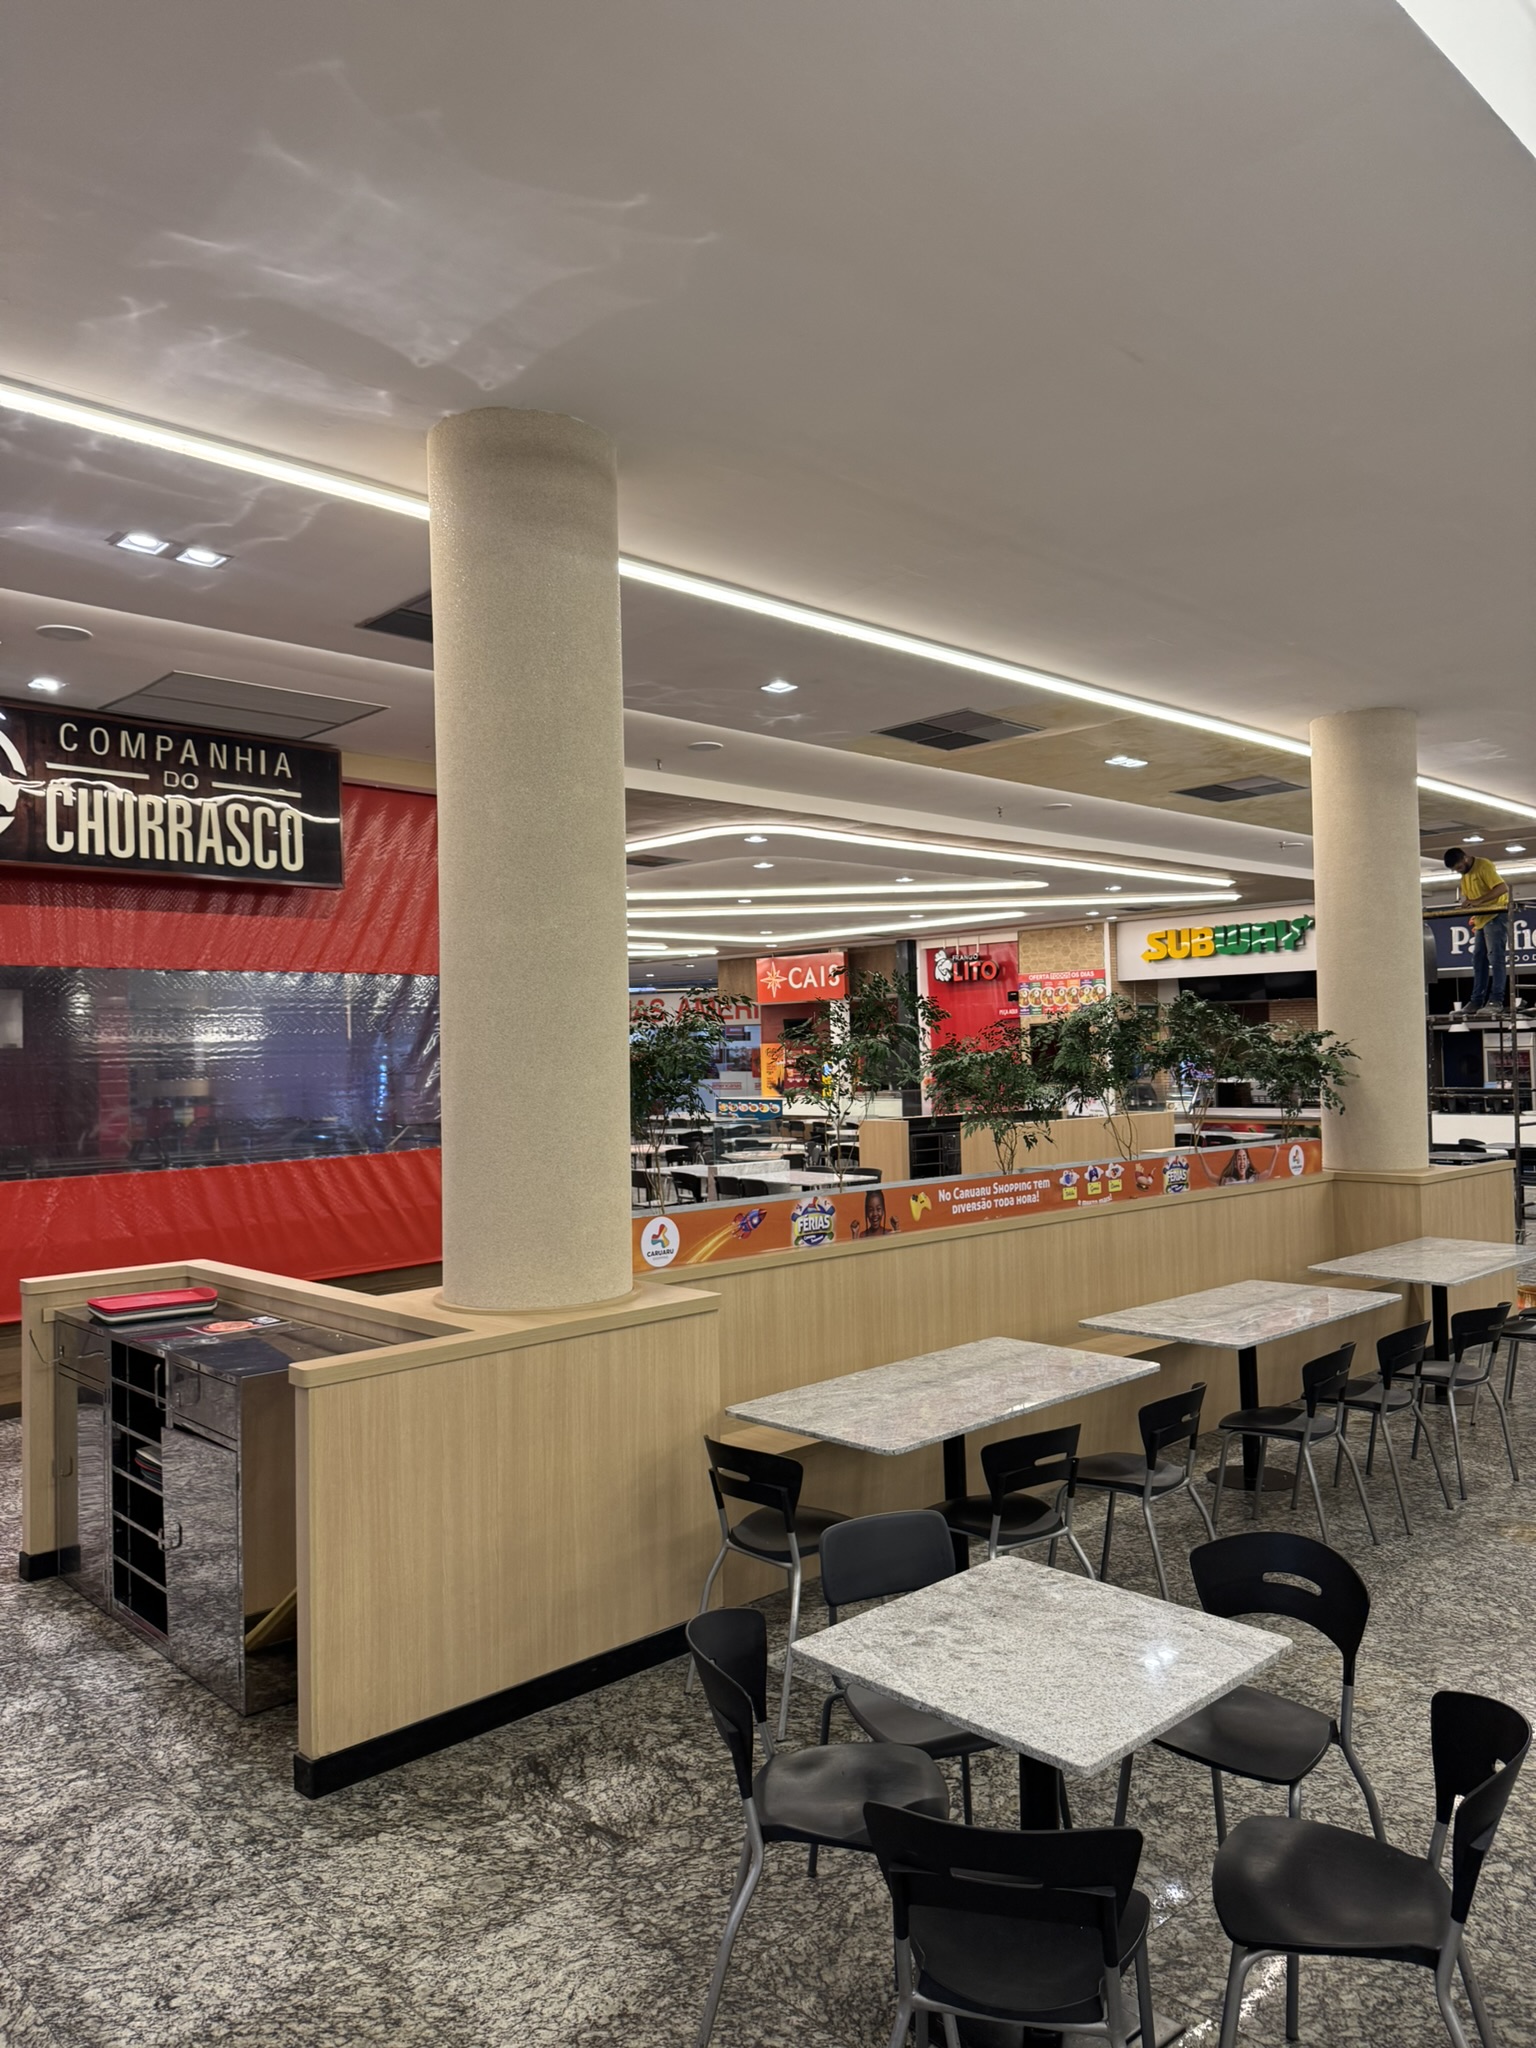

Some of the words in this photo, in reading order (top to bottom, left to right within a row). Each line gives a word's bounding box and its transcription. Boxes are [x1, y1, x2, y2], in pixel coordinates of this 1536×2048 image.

[59, 722, 293, 779] COMPANHIA
[163, 770, 200, 790] DO
[46, 783, 304, 872] CHURRASCO
[1140, 914, 1316, 963] SUBWAY
[952, 953, 979, 962] FRANGO
[952, 960, 999, 983] LITO
[1028, 973, 1050, 981] OFERTA
[1070, 971, 1080, 979] OS
[1080, 970, 1095, 978] DIAS
[797, 1215, 831, 1233] FÉRIAS
[646, 1248, 675, 1257] CARUARU
